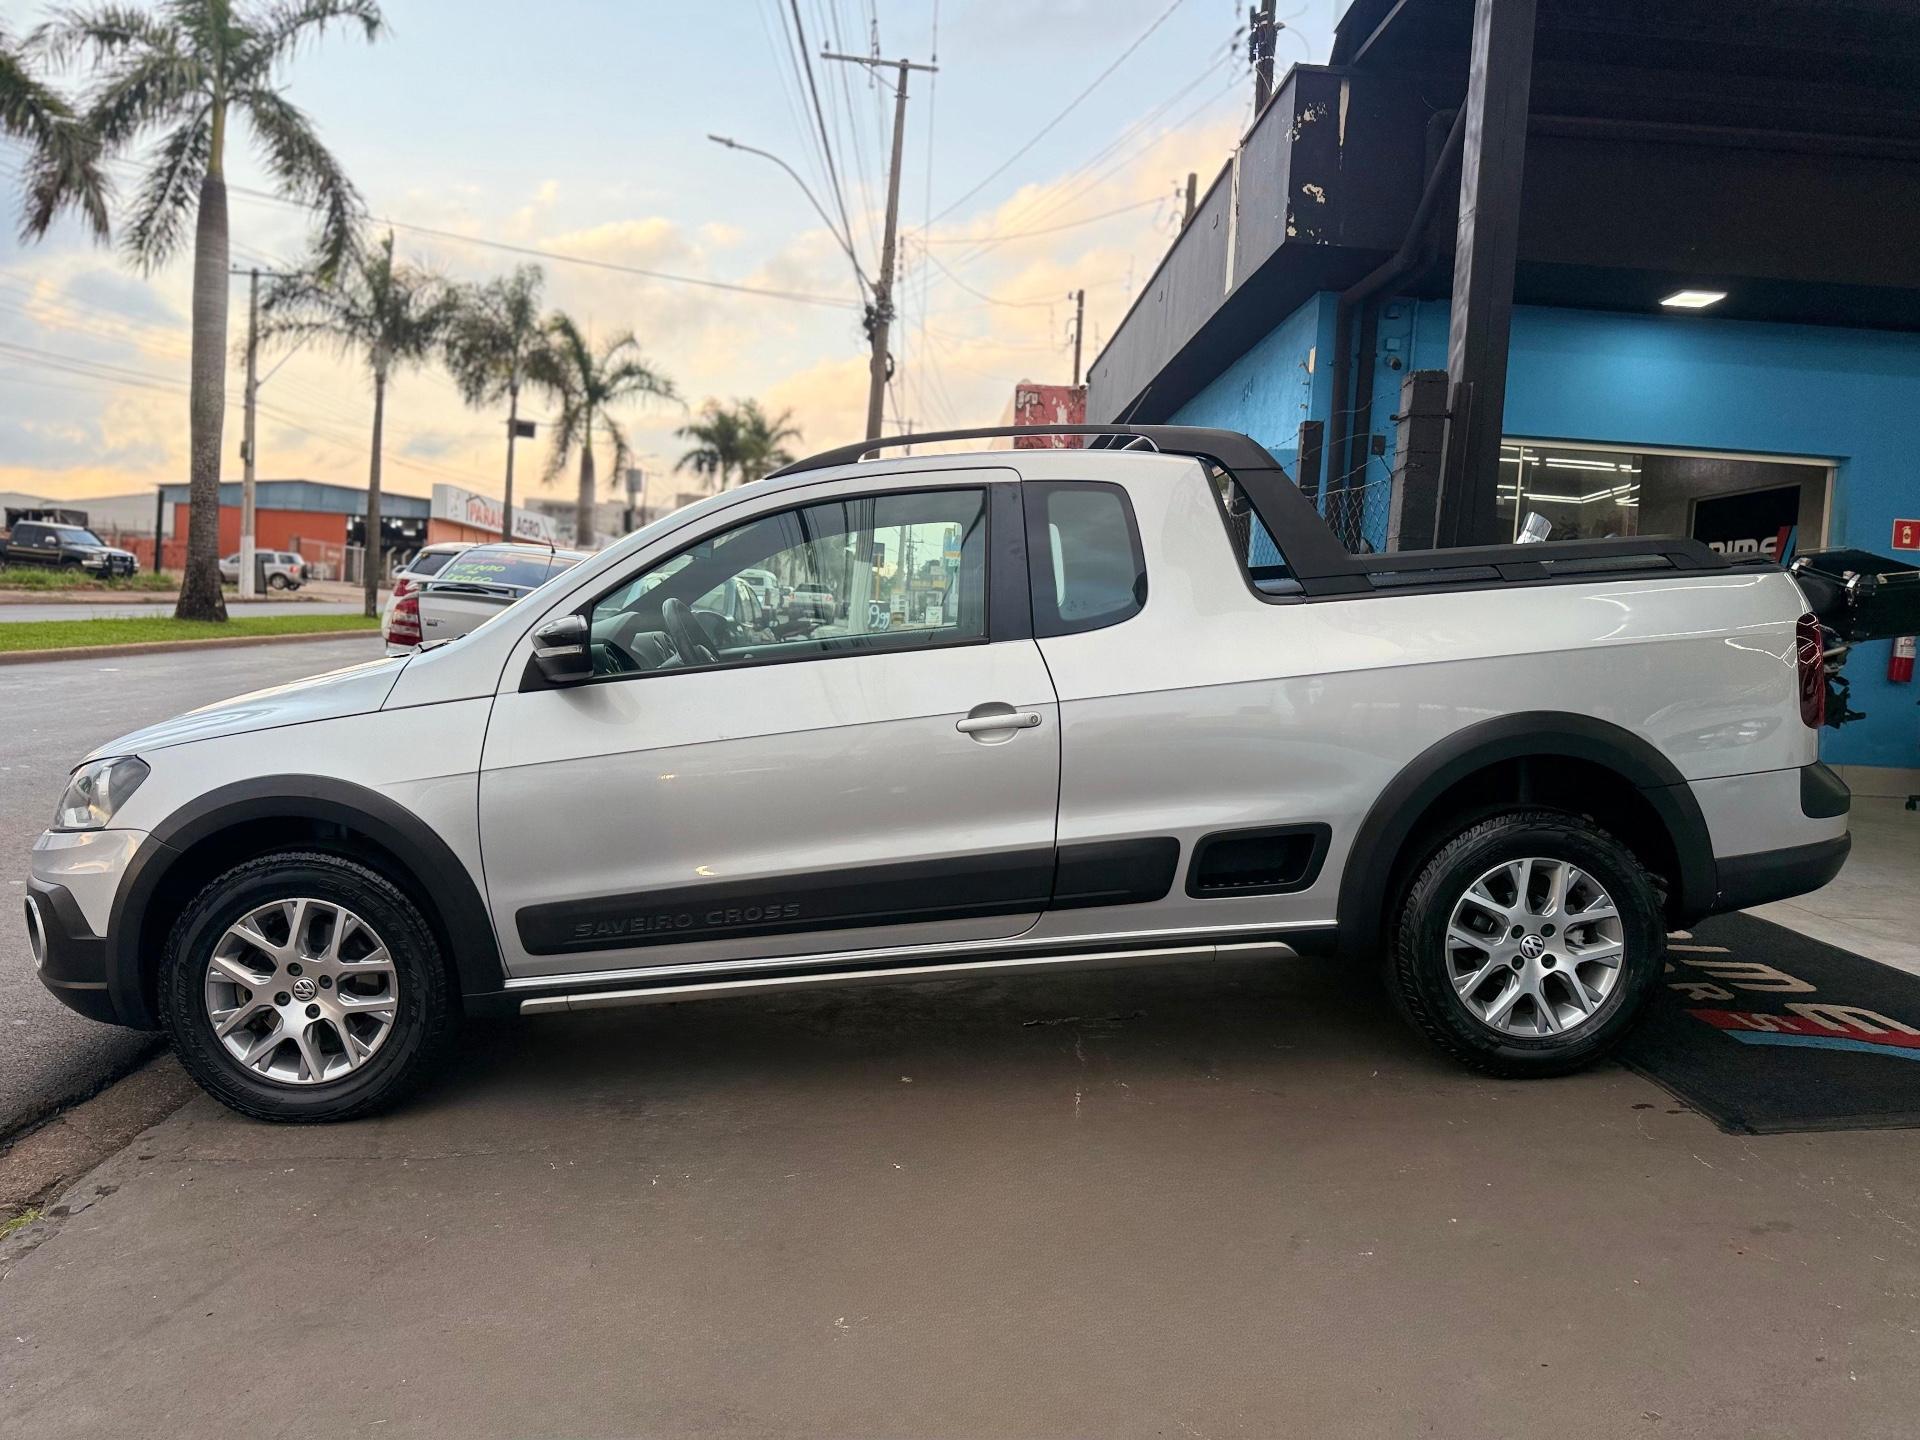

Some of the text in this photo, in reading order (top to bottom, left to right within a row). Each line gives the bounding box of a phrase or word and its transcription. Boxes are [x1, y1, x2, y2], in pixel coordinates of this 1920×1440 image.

[516, 516, 540, 538] AGRO
[574, 902, 801, 937] SAVEIRO CROSS
